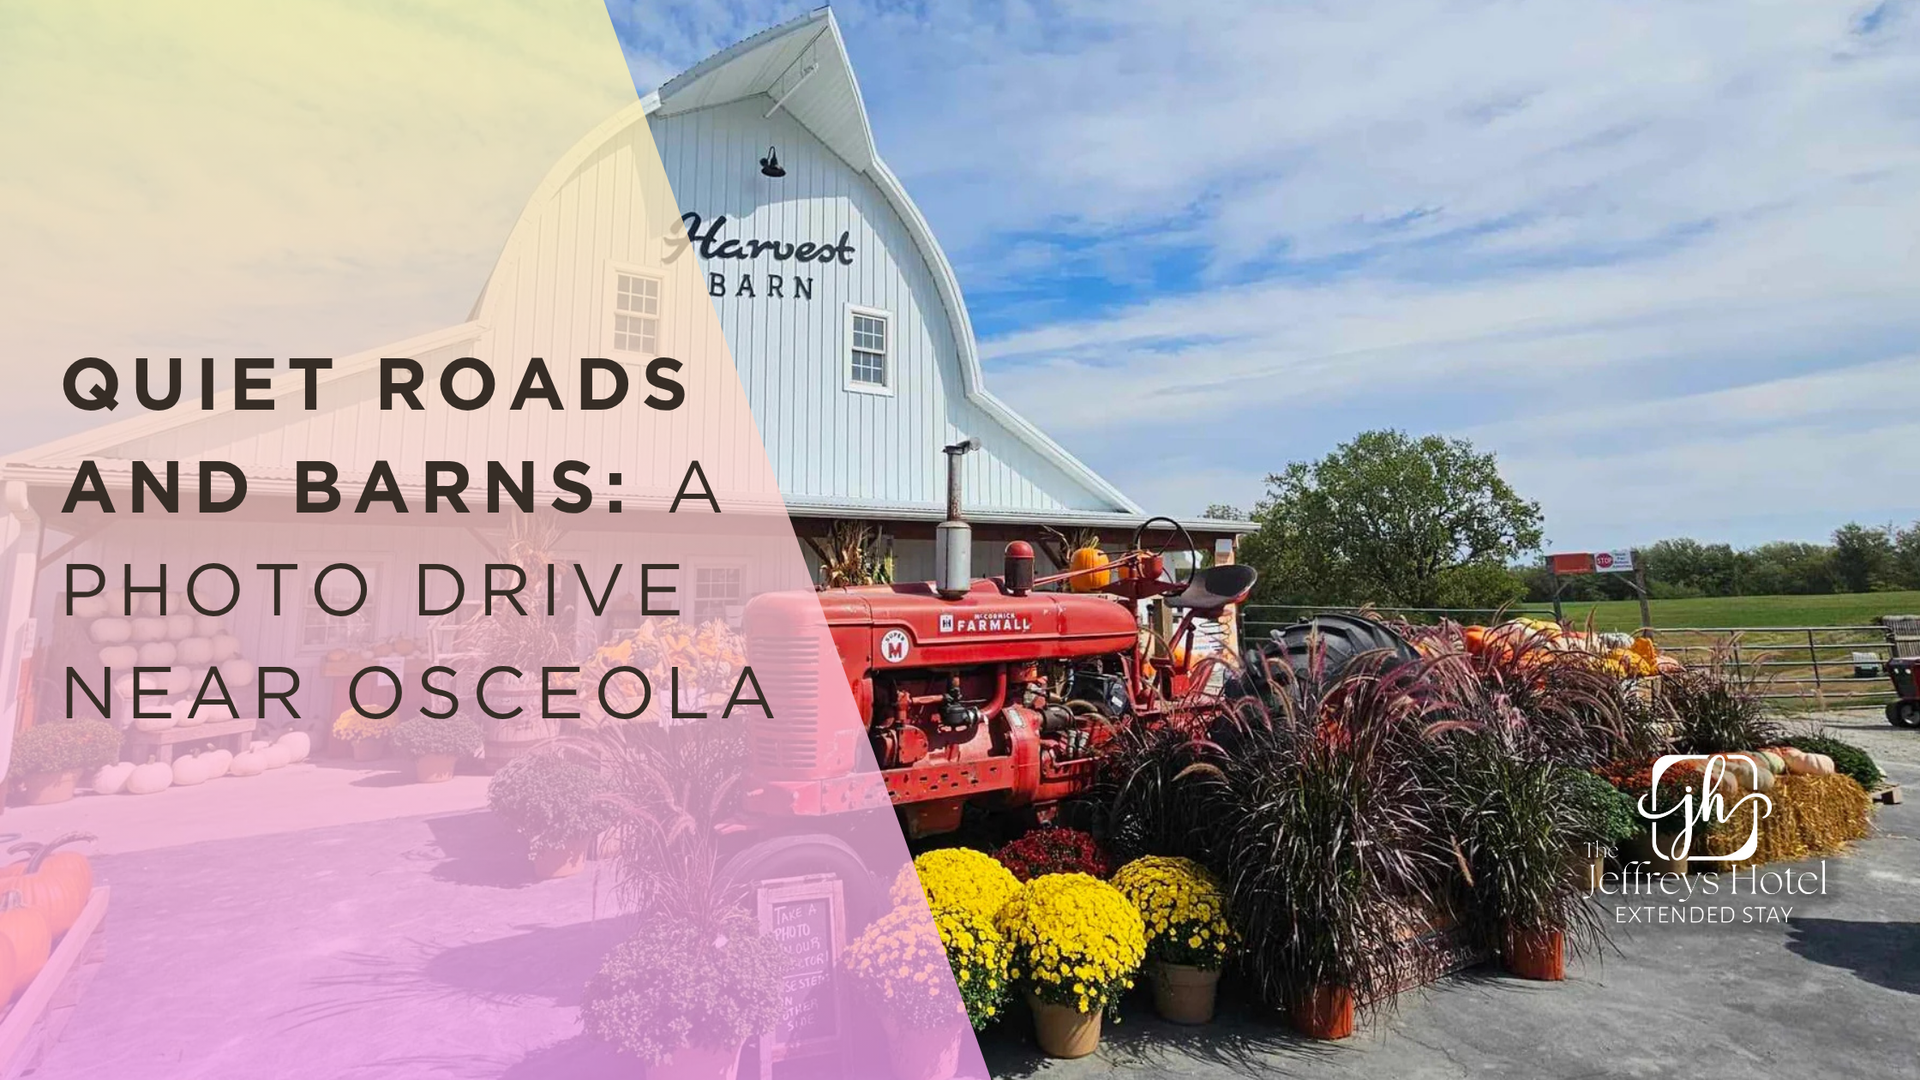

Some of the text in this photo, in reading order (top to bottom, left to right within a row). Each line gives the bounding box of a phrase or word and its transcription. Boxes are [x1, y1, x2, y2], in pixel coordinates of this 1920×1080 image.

[661, 211, 856, 266] Harvest
[708, 271, 814, 301] BARN
[1596, 557, 1612, 565] STOP
[957, 618, 1031, 632] FARMALL
[885, 632, 906, 642] SUPER
[888, 642, 903, 659] M
[774, 903, 817, 925] TAKE A
[773, 923, 811, 941] PHOTO
[795, 936, 821, 954] OUR
[787, 1013, 815, 1032] SIDE
